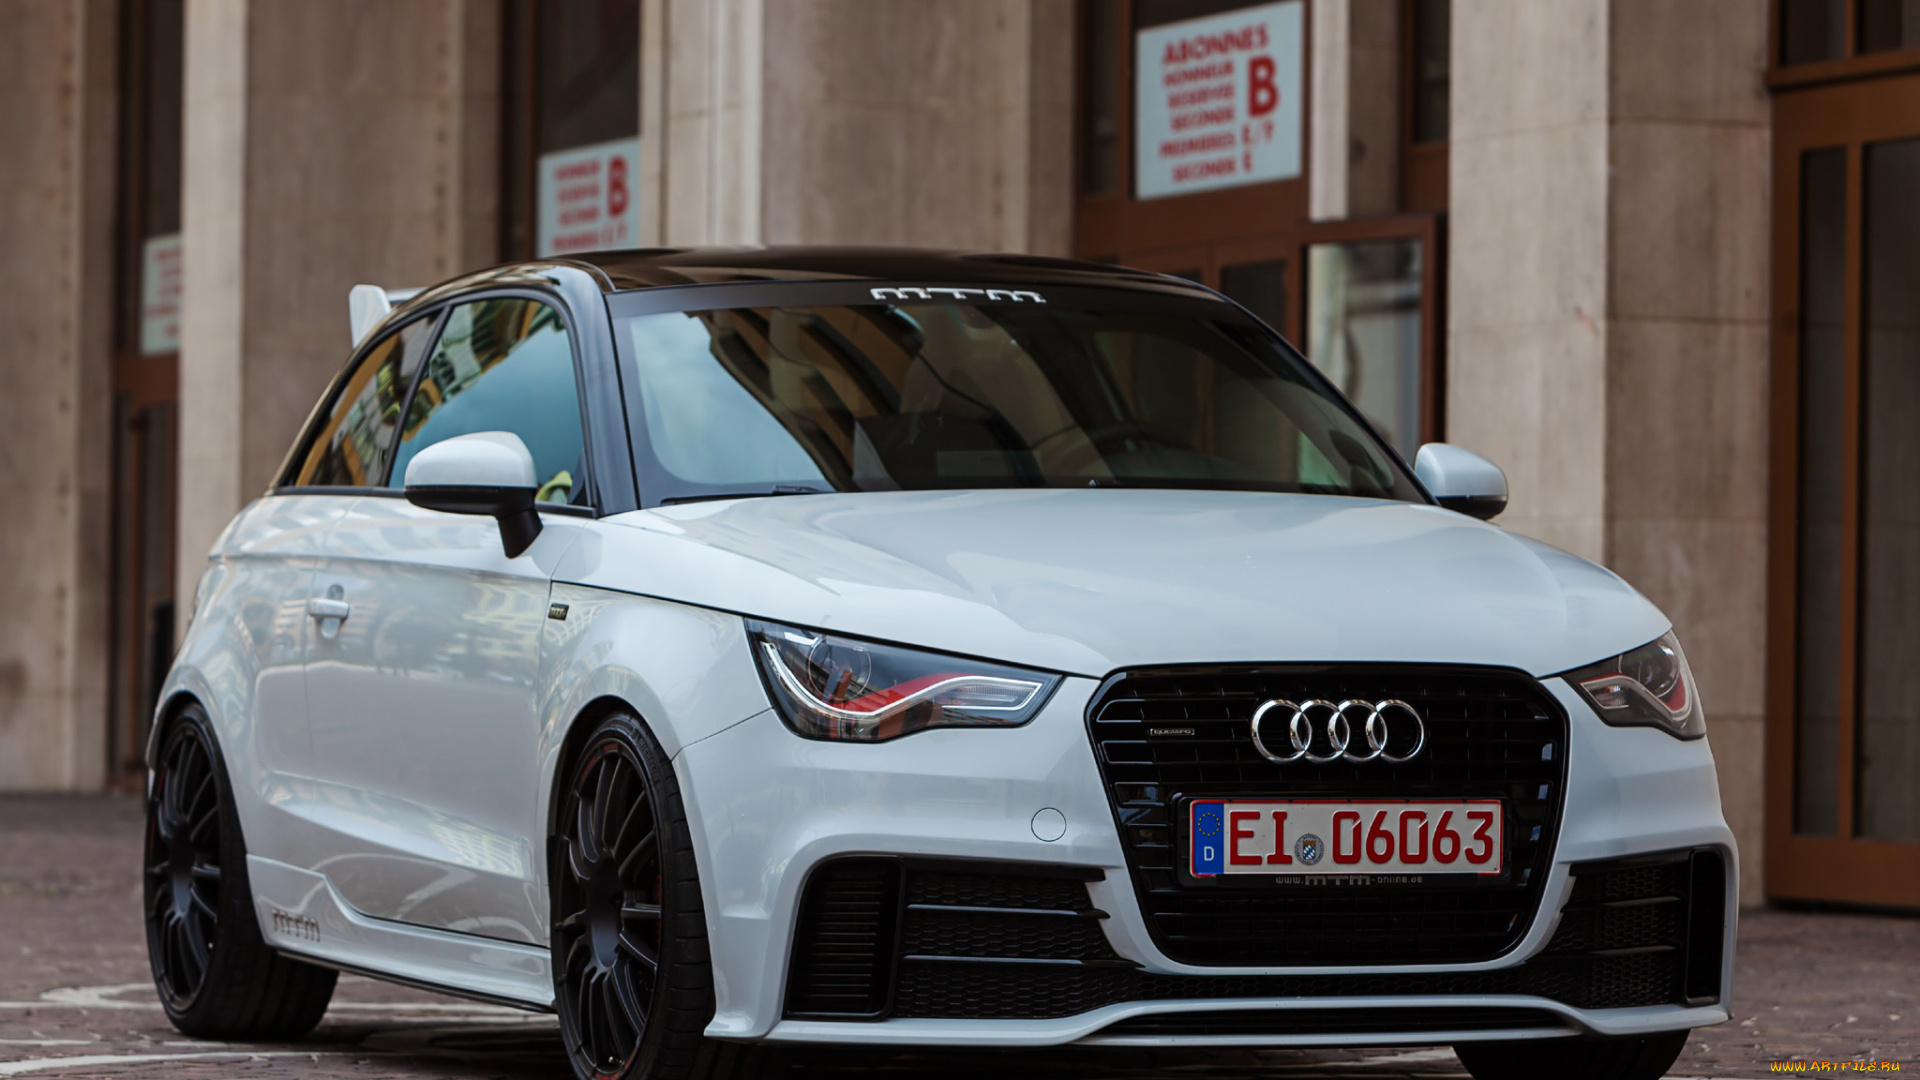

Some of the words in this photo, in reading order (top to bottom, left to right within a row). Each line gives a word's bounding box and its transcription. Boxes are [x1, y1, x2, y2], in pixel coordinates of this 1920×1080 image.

[1162, 22, 1269, 65] ABONNES
[1248, 55, 1279, 117] B
[607, 155, 630, 217] B
[1203, 846, 1215, 861] D
[1229, 811, 1293, 865] EI
[1332, 811, 1495, 865] 06063
